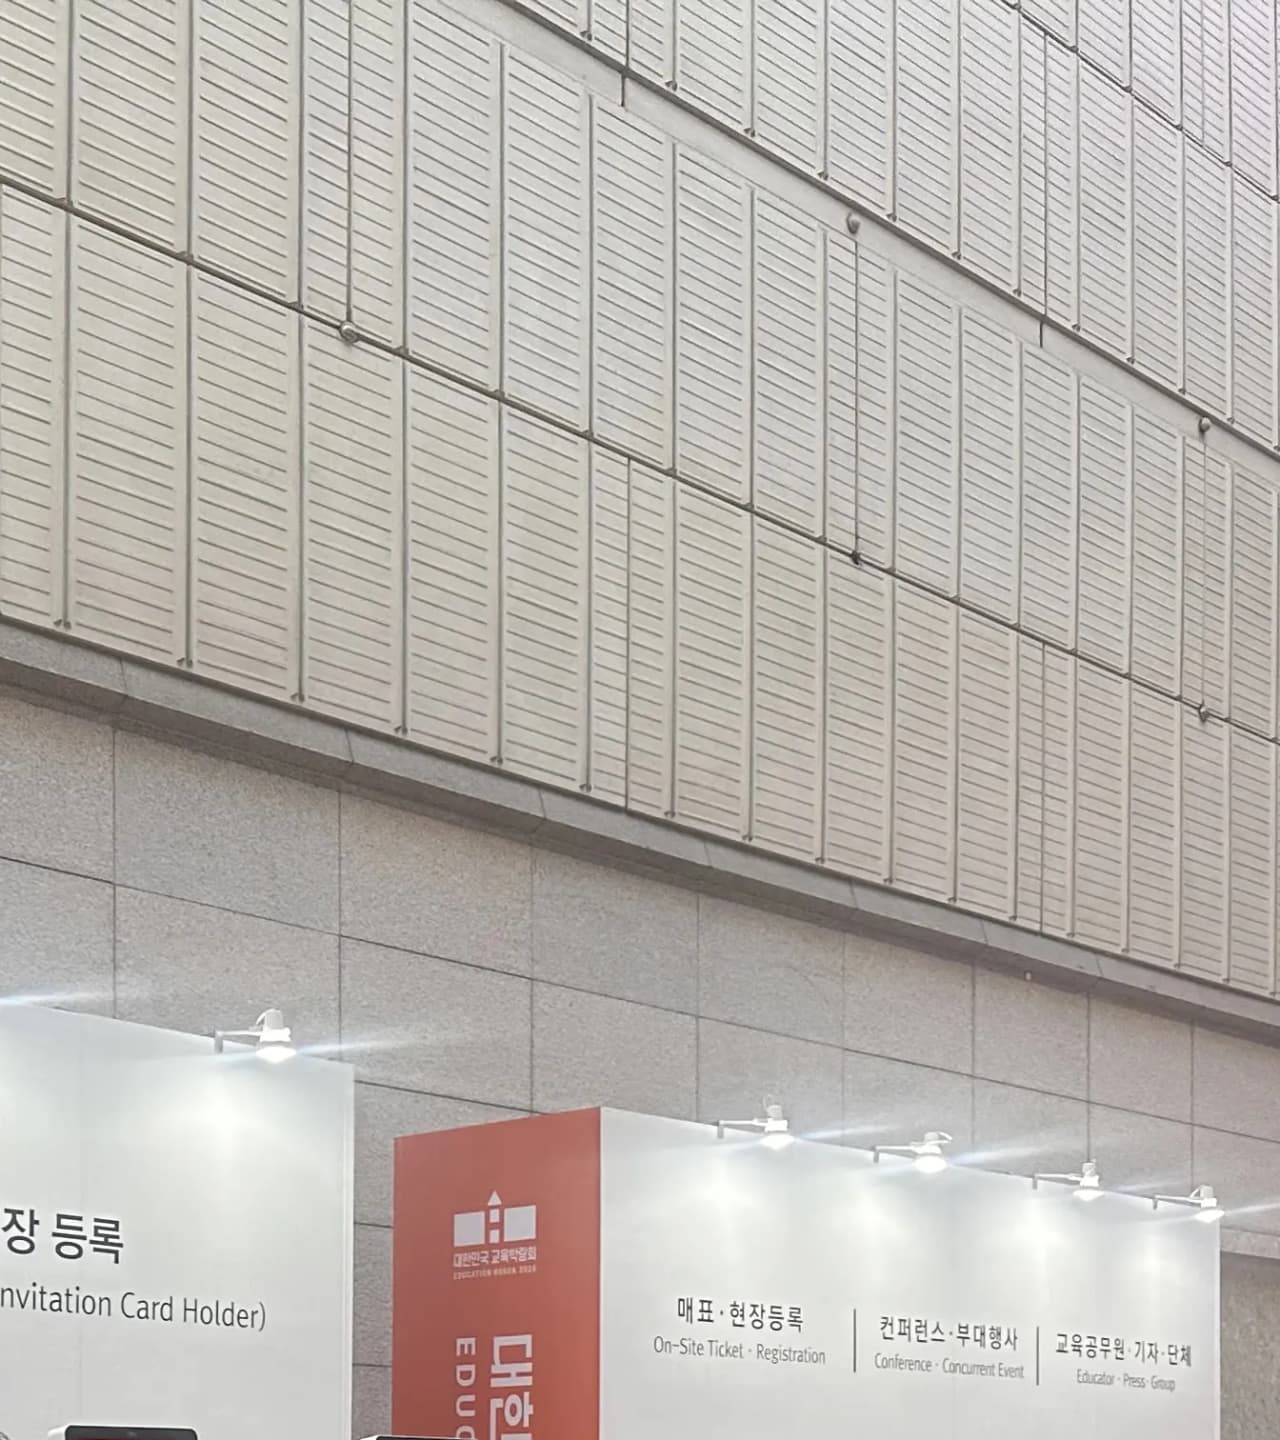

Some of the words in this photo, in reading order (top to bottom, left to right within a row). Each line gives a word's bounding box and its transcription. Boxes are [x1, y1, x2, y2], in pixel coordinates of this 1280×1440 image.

[51, 1213, 124, 1265] 등록
[121, 1292, 174, 1323] Card
[182, 1298, 267, 1333] Holder)
[654, 1336, 705, 1356] On-Site
[707, 1340, 744, 1359] Ticket
[756, 1343, 826, 1364] Registration
[874, 1353, 932, 1372] Conference
[998, 1362, 1025, 1379] Event
